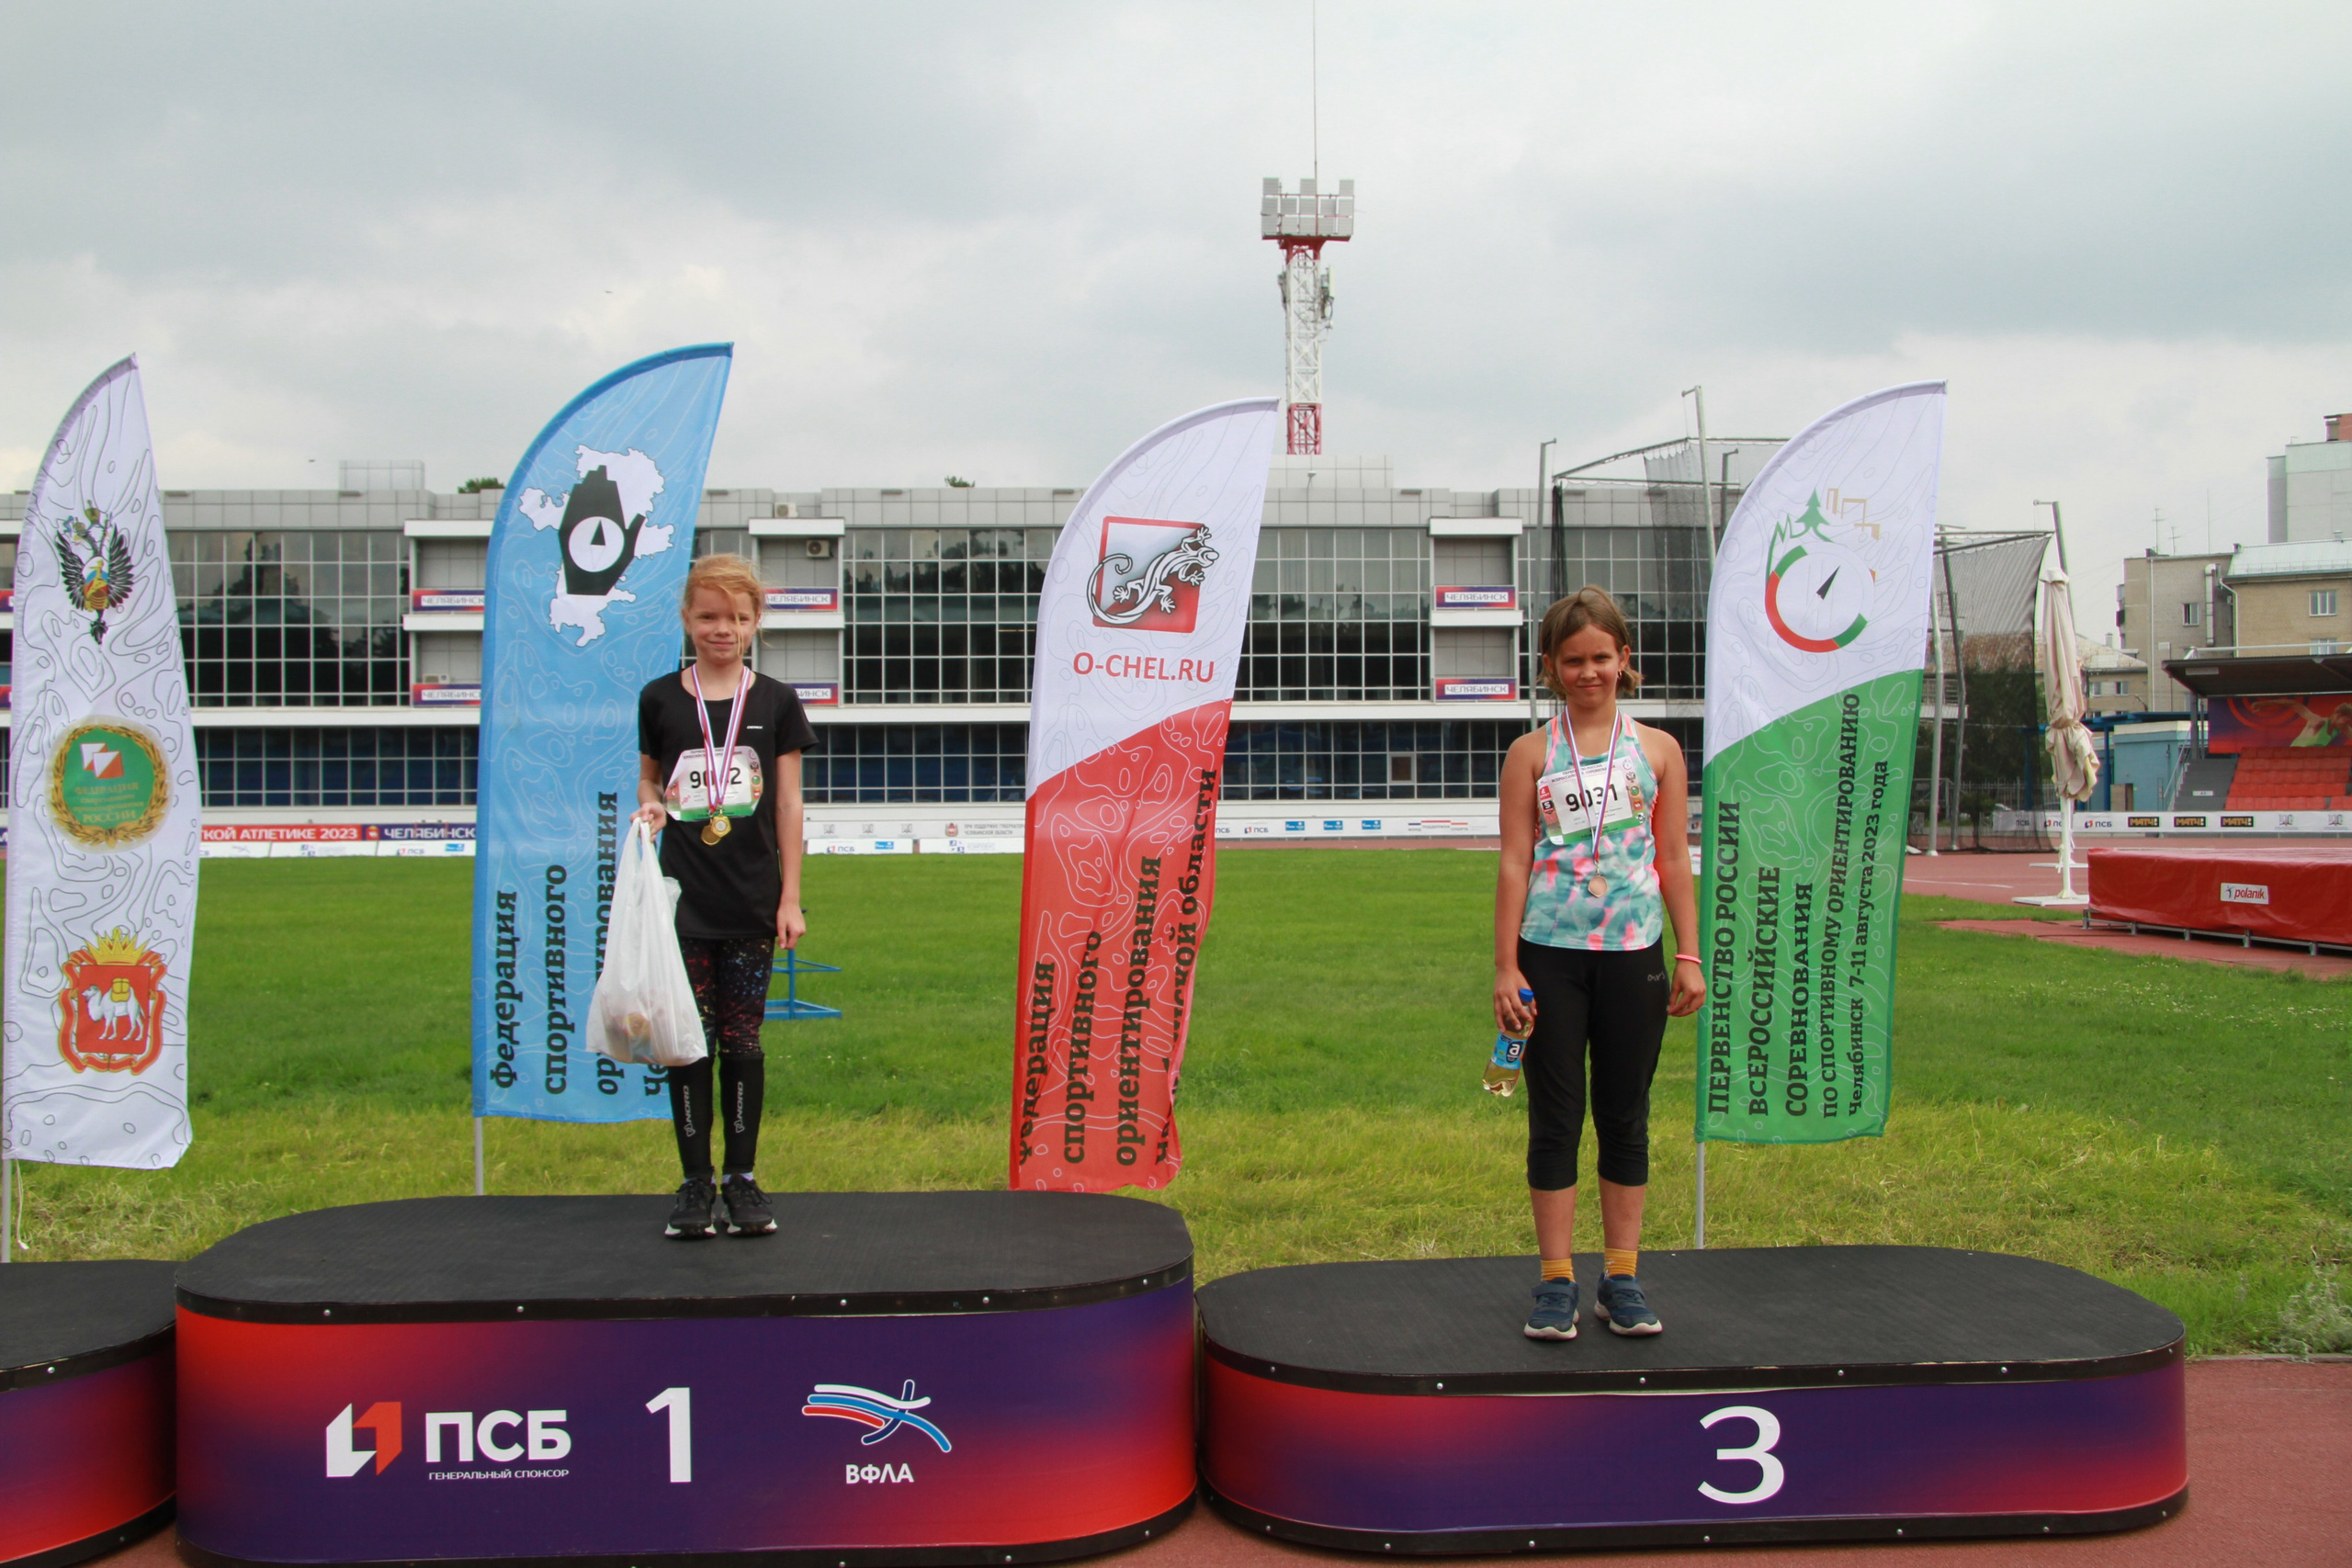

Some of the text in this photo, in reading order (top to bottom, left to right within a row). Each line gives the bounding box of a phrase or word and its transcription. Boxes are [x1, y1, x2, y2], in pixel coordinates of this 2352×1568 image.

[423, 690, 481, 698] ЧЕЛЯБИНС
[1073, 652, 1215, 682] O-CHEL.RU
[689, 767, 742, 789] 902
[1565, 784, 1618, 812] 9031
[201, 827, 358, 840] КОЙ АТЛЕТИКЕ 2023
[384, 828, 476, 839] ЧЕЛЯБИНСК
[1178, 769, 1217, 915] области
[1820, 694, 1860, 1119] ПО СПОРТИВНОМУ ОРИЕНТИРОВАНИЮ
[1847, 761, 1890, 1117] Челябинск 7-11 августа 2023 года
[2233, 887, 2265, 899] polanik
[490, 890, 523, 1089] Федерация
[545, 864, 575, 1095] спортивного
[1708, 801, 1740, 1114] ПЕРВЕНСТВО РОССИИ
[1747, 866, 1781, 1116] ВСЕРОССИЙСКИЕ
[1785, 883, 1814, 1117] СОРЕВНОВАНИЯ
[1064, 931, 1102, 1164] спортивного
[1116, 856, 1162, 1166] ориентирования
[425, 1409, 572, 1462] ПСБ
[428, 1468, 570, 1480] ГЕНЕРАЛЬНЫЙ СПОНСОР
[645, 1387, 692, 1483] 1
[845, 1462, 915, 1483] ВФЛА
[1697, 1405, 1785, 1505] 3
